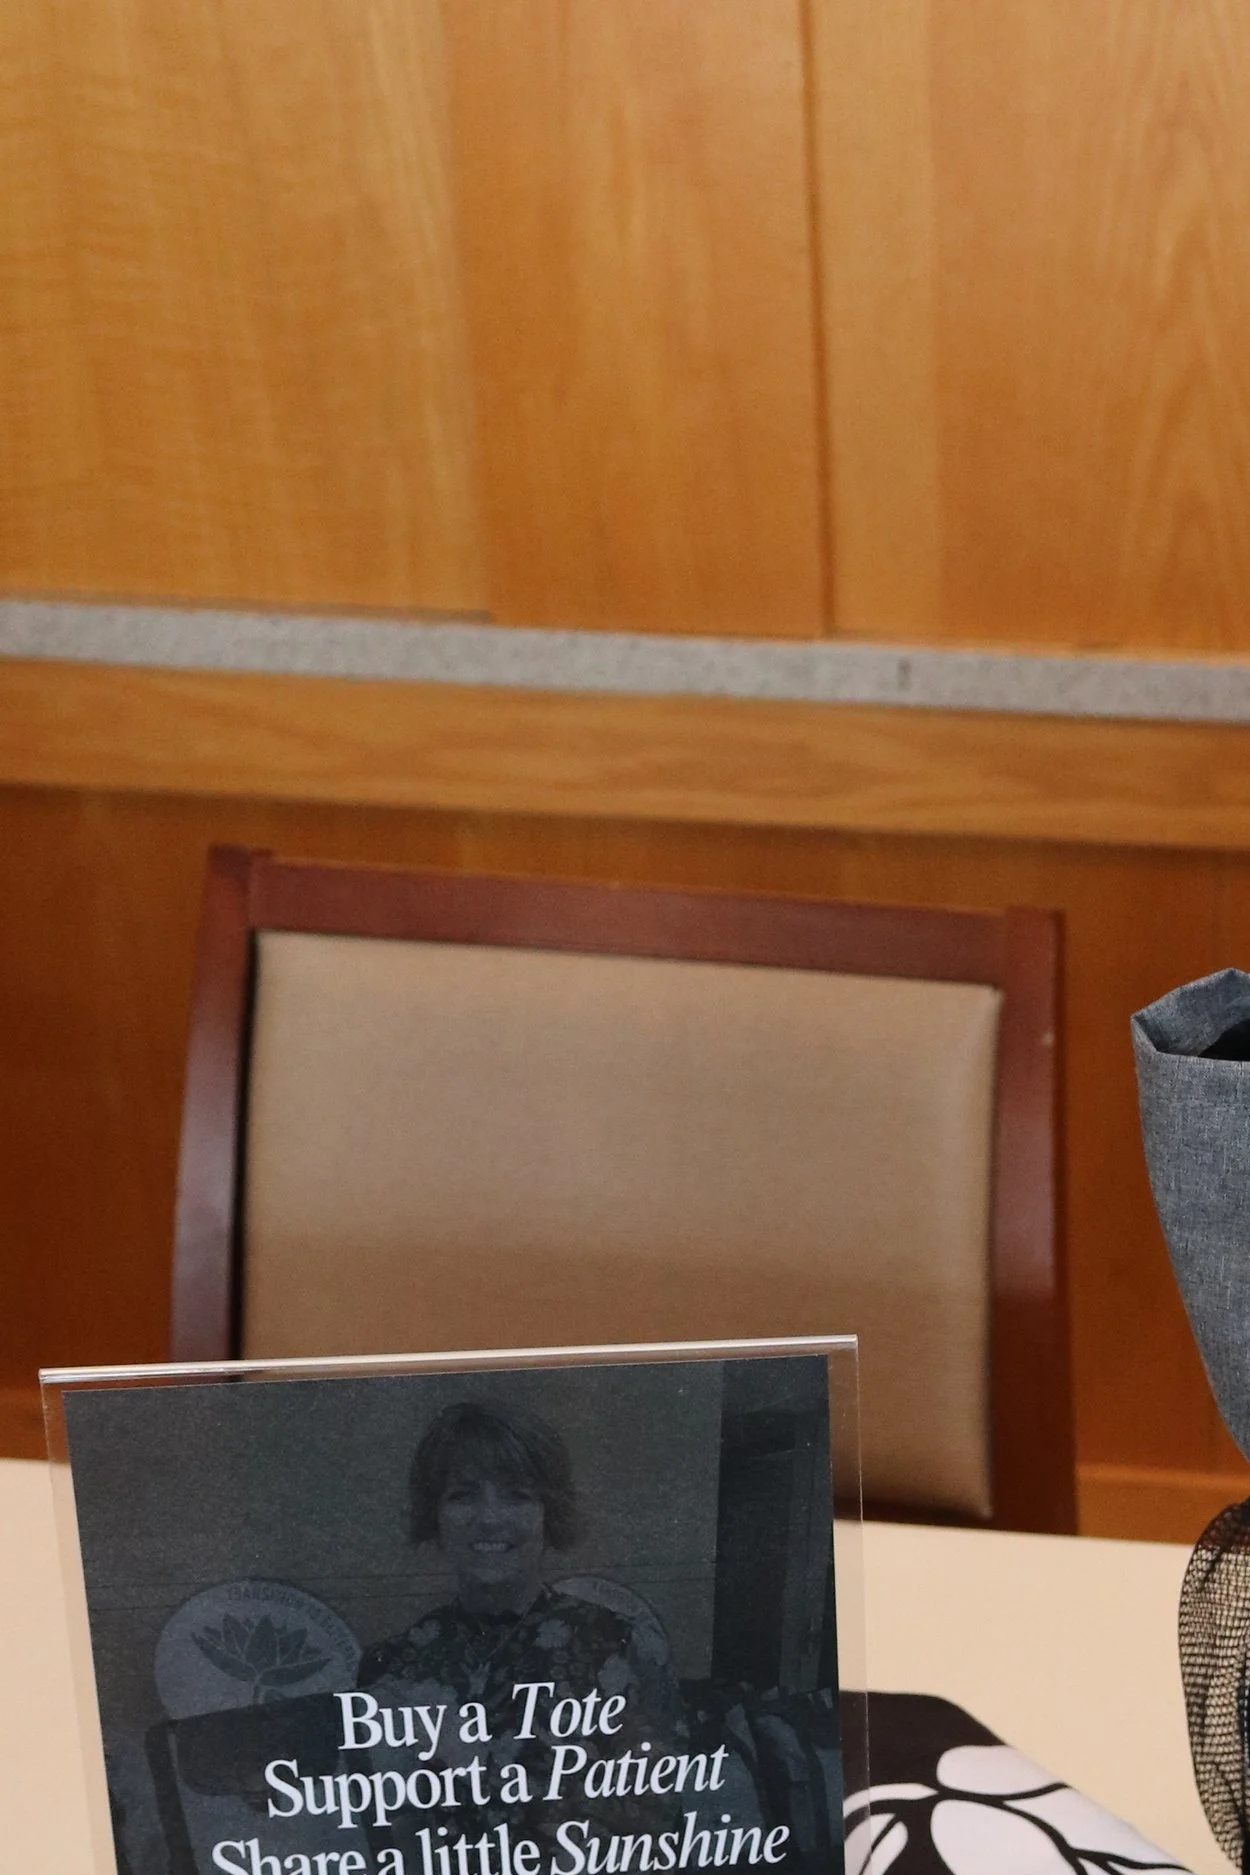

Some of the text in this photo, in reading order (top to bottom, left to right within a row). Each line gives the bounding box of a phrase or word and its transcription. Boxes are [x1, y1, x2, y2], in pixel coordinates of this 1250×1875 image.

[333, 1682, 626, 1761] Buy a Tote
[264, 1742, 729, 1829] Support a Patient
